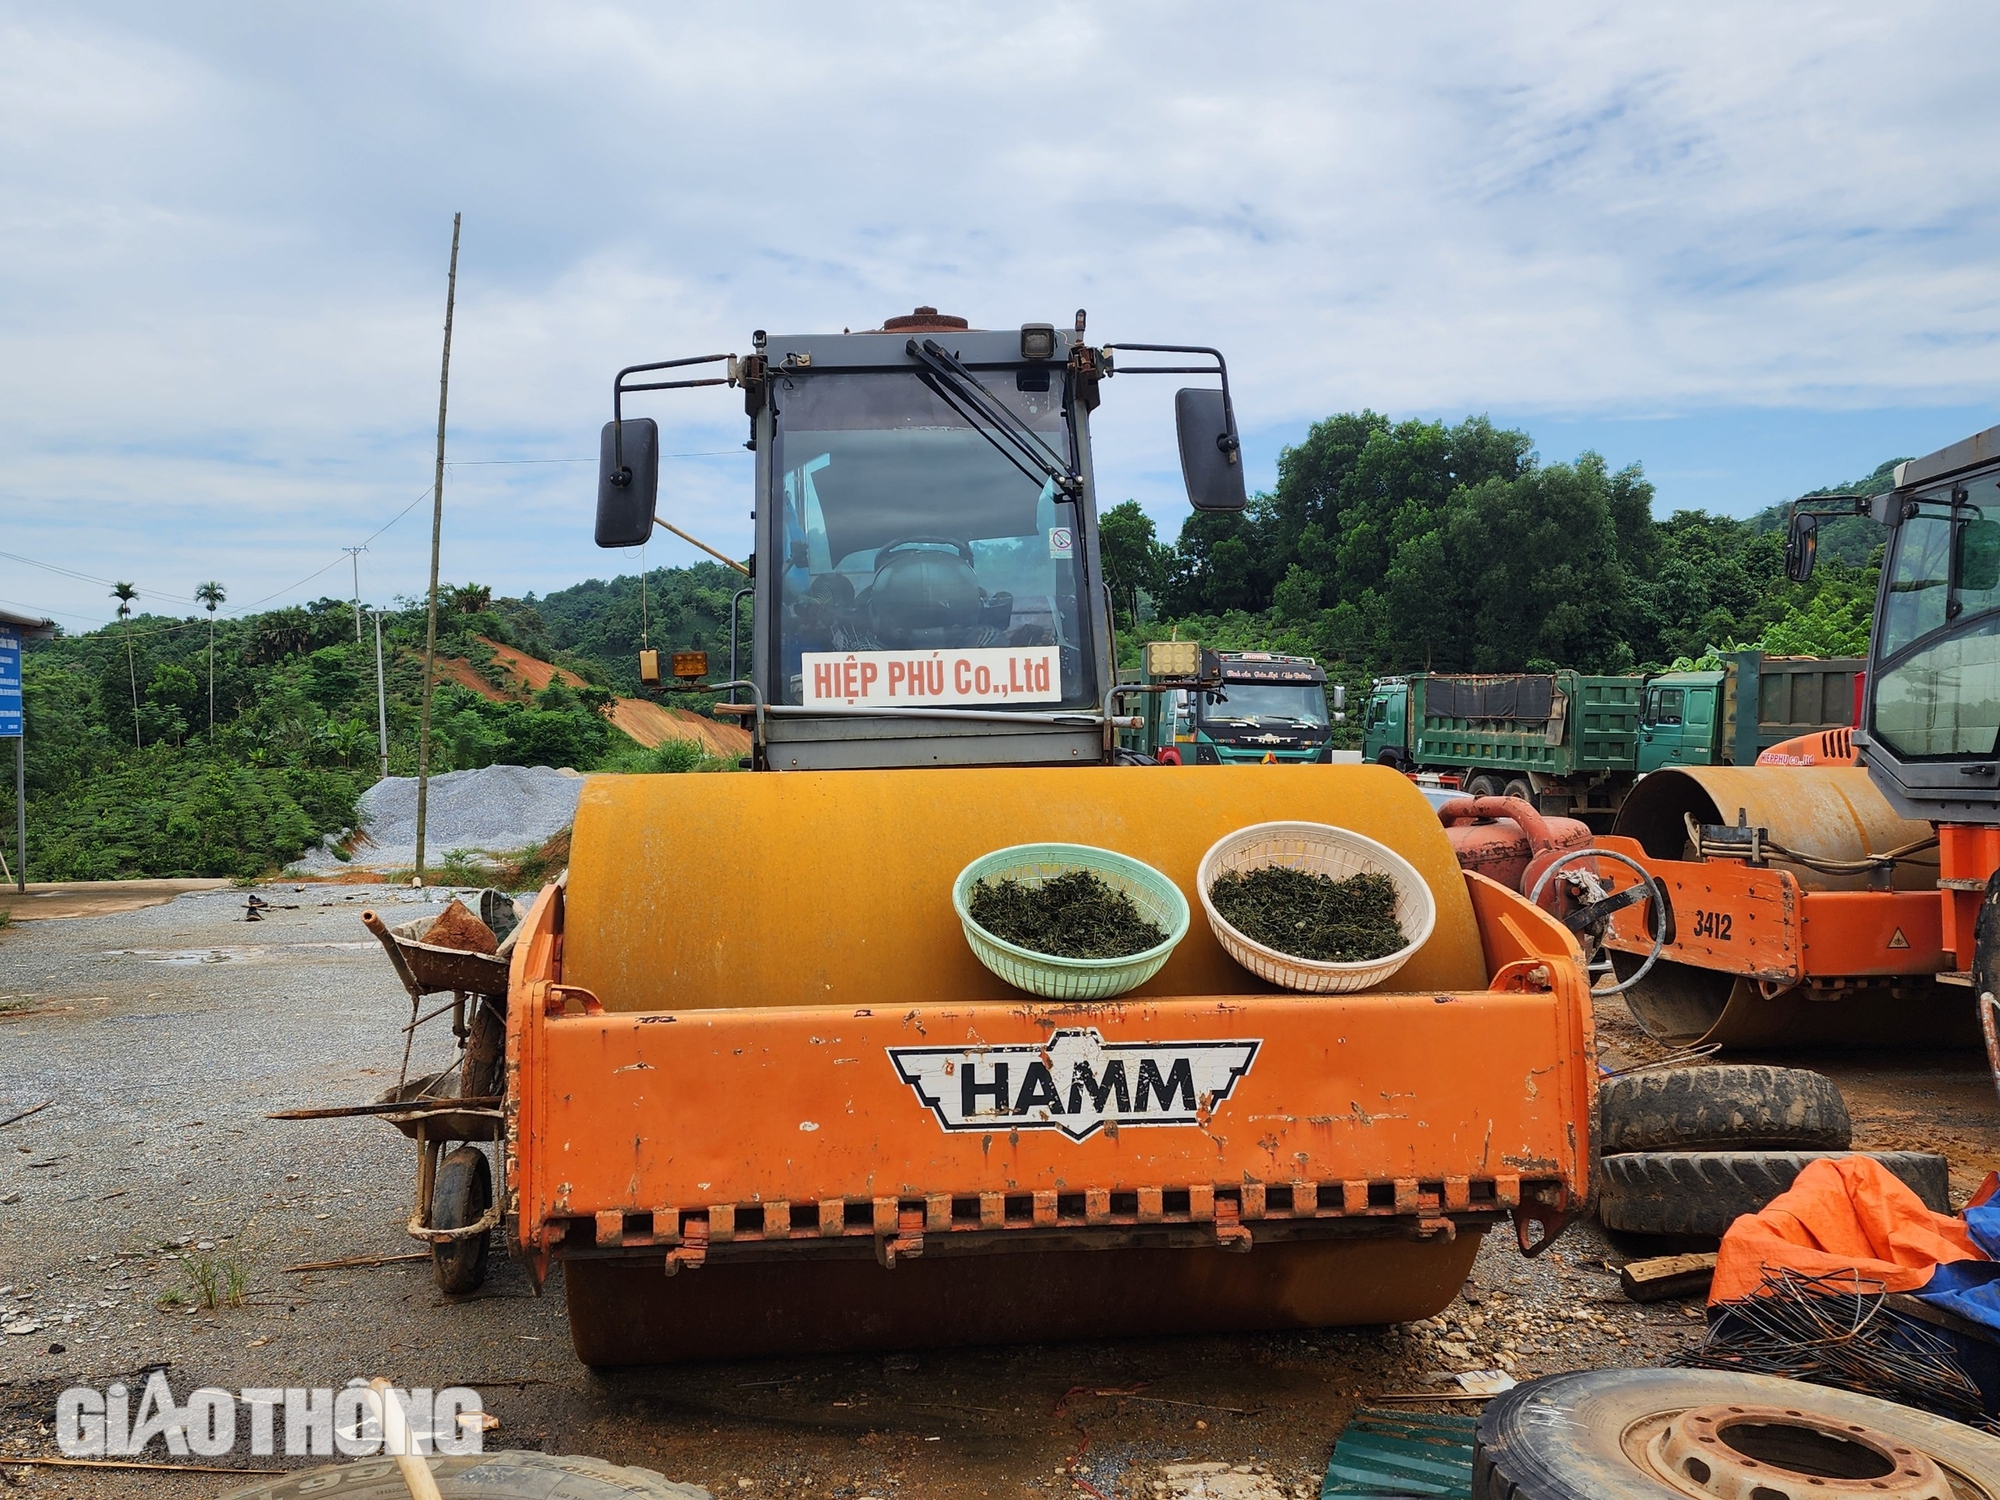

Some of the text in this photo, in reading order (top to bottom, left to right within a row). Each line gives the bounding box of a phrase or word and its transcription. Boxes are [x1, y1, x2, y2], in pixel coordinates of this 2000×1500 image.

[814, 652, 1050, 705] HIỆP PHÚ Co.,Ltd
[1693, 910, 1733, 942] 3412
[961, 1058, 1198, 1117] HAMM
